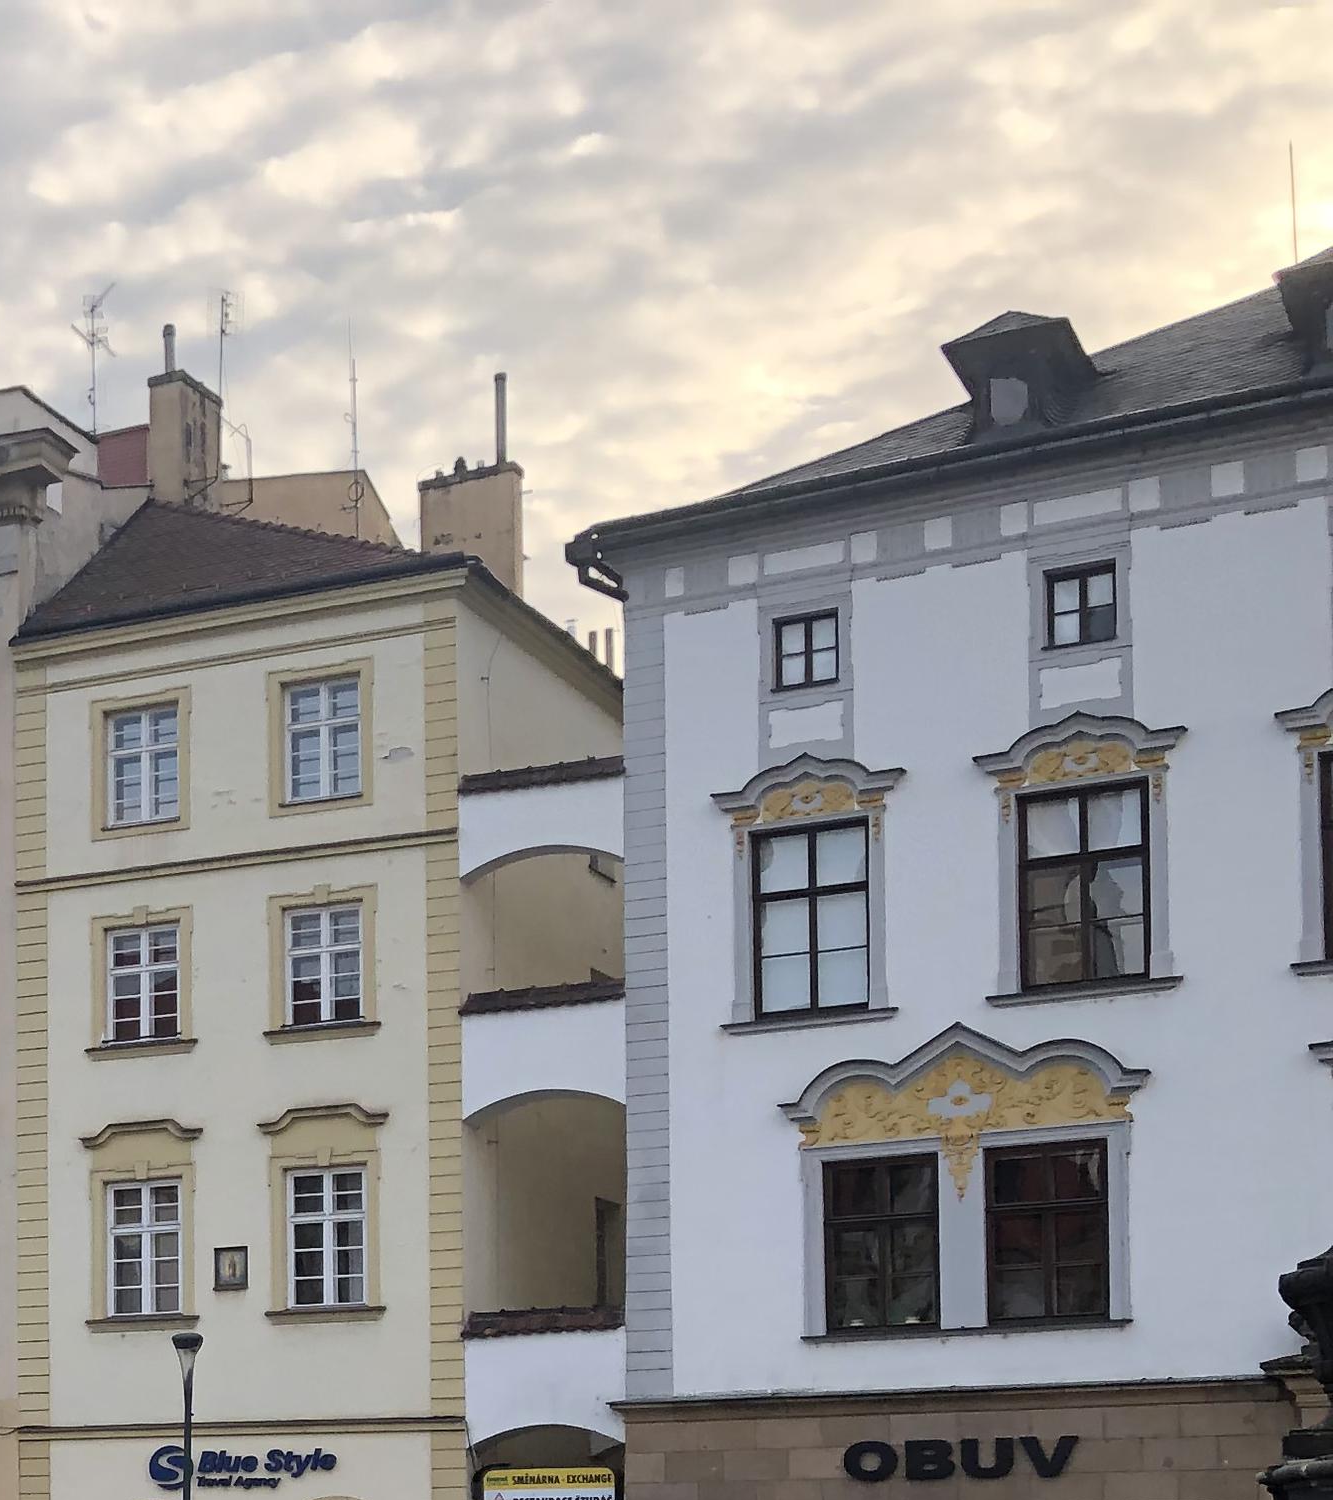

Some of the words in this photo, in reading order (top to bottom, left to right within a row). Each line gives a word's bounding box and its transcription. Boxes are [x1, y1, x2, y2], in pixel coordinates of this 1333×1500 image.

[198, 1450, 259, 1474] Blue
[264, 1447, 337, 1478] Style
[843, 1435, 1079, 1481] OBUV
[197, 1475, 233, 1487] Travel
[234, 1476, 281, 1489] Agency
[566, 1473, 612, 1484] EXCHANGE
